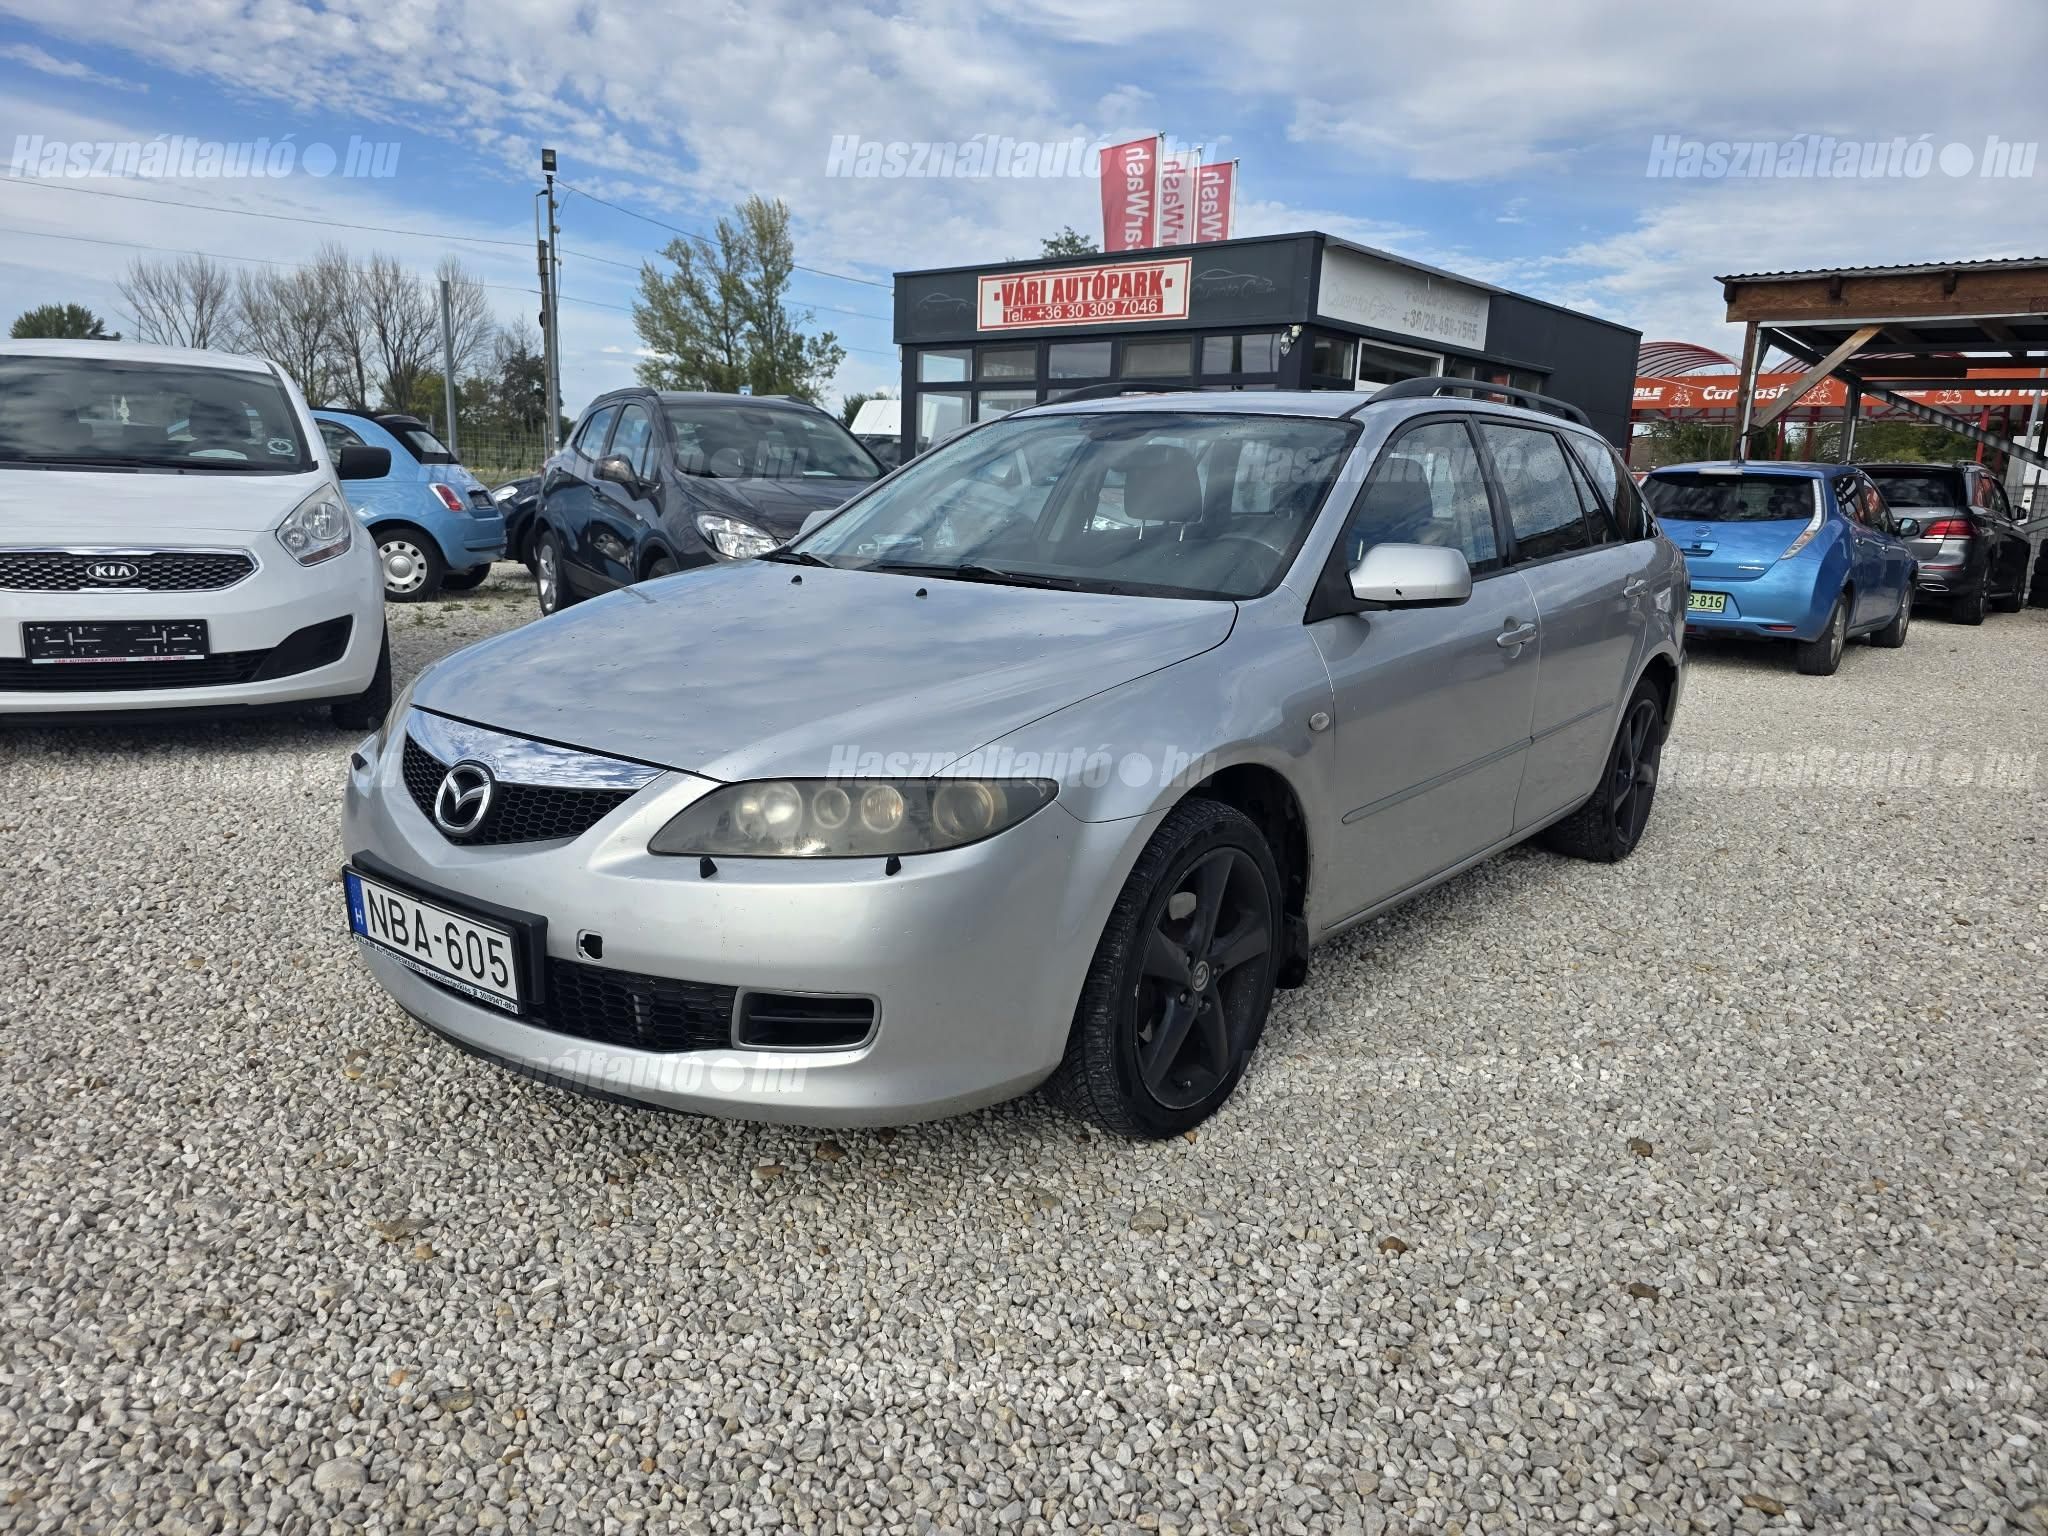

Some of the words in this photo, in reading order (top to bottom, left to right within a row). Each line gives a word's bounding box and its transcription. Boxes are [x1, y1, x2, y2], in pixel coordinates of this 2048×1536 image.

[1001, 277, 1047, 308] VÁRI
[1052, 269, 1165, 304] AUTÓPARK
[1005, 309, 1032, 323] Tel.:
[1037, 306, 1062, 320] +36
[1067, 305, 1084, 318] 30
[1089, 302, 1116, 317] 309
[1121, 299, 1158, 314] 7046
[95, 564, 130, 578] KIA
[354, 908, 364, 925] H
[367, 889, 509, 988] NBA-605
